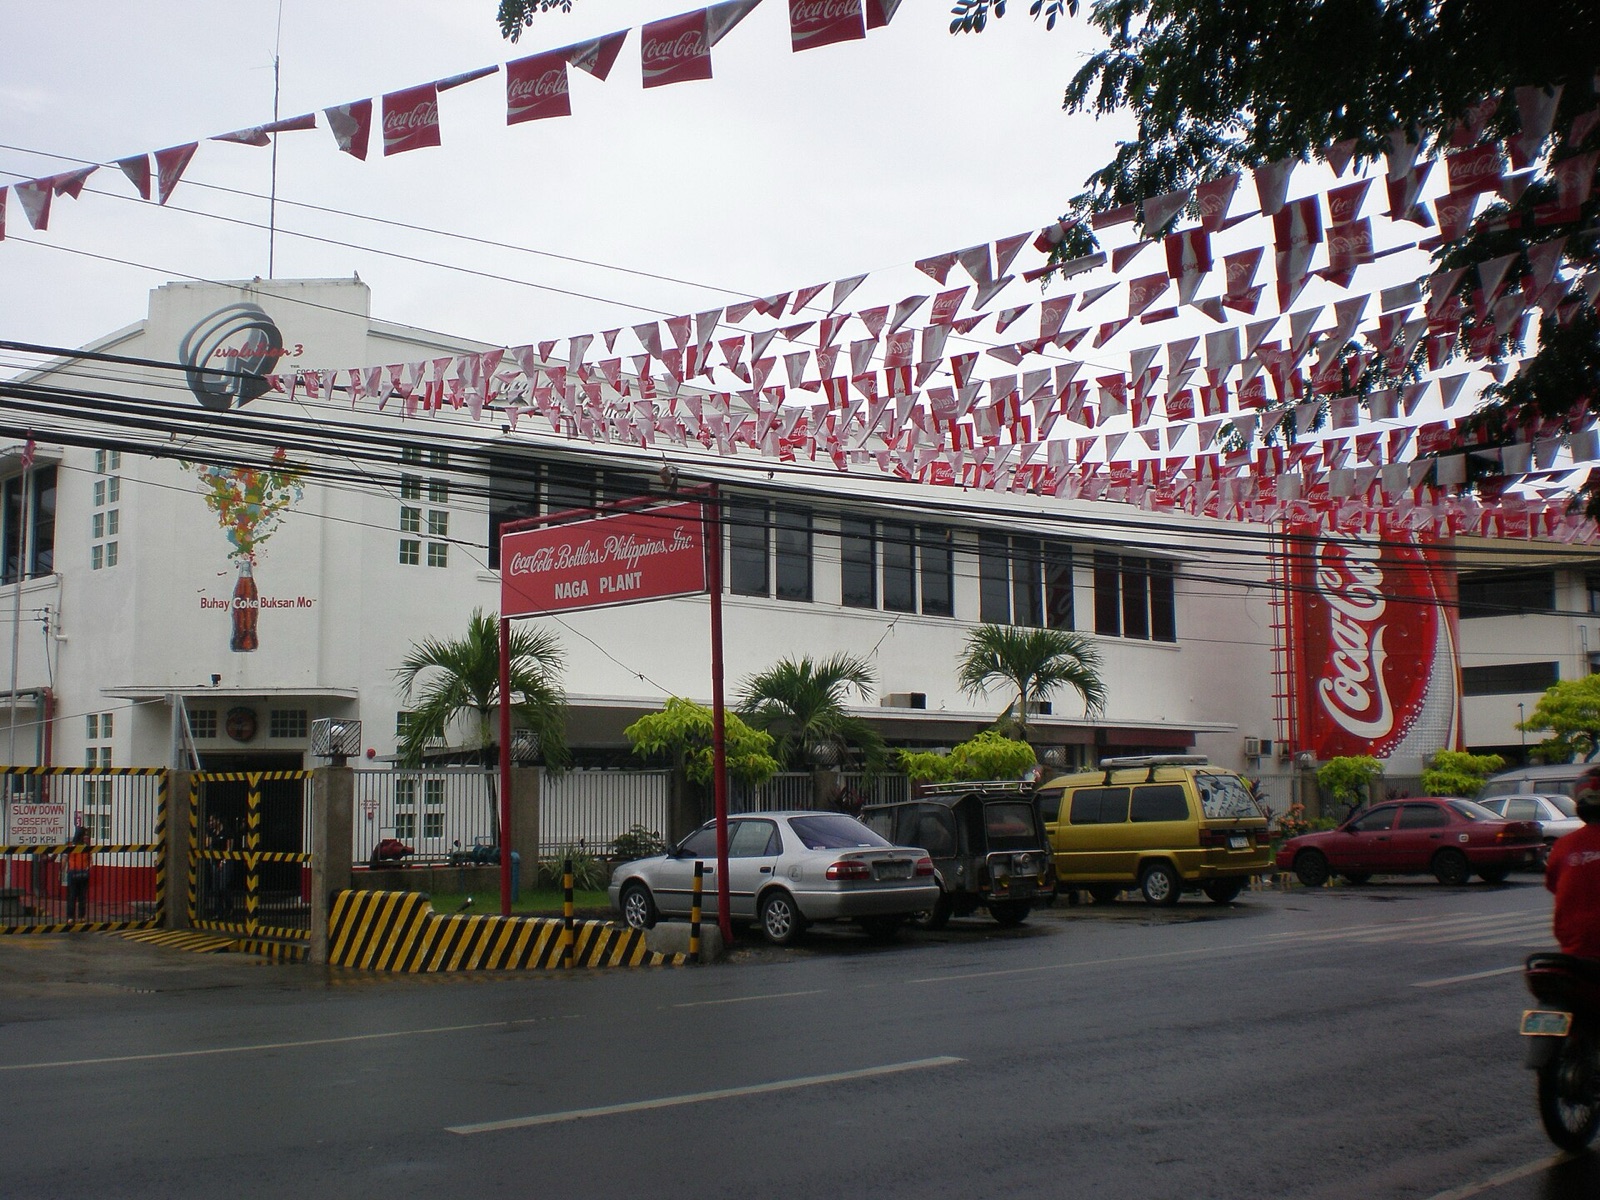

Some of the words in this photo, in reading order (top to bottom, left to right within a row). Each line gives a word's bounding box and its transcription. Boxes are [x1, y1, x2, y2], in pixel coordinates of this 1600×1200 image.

[214, 341, 292, 358] evolution
[293, 344, 304, 357] 3
[510, 546, 554, 576] Coca-Cola
[554, 540, 599, 570] Bottlers
[600, 532, 668, 570] Philippines,
[669, 525, 694, 551] Inc.
[554, 579, 589, 600] NAGA
[600, 571, 642, 594] PLANT
[200, 597, 230, 612] Buhay
[233, 597, 259, 609] Coke
[260, 597, 295, 608] Buksan
[1315, 532, 1393, 739] Coca-Col
[13, 805, 37, 815] SLOW
[40, 805, 64, 815] DOWN
[17, 817, 59, 825] OBSERVE
[11, 827, 38, 835] SPEED
[40, 826, 64, 835] LIMIT
[19, 836, 37, 844] 5-10
[40, 836, 56, 844] KPH
